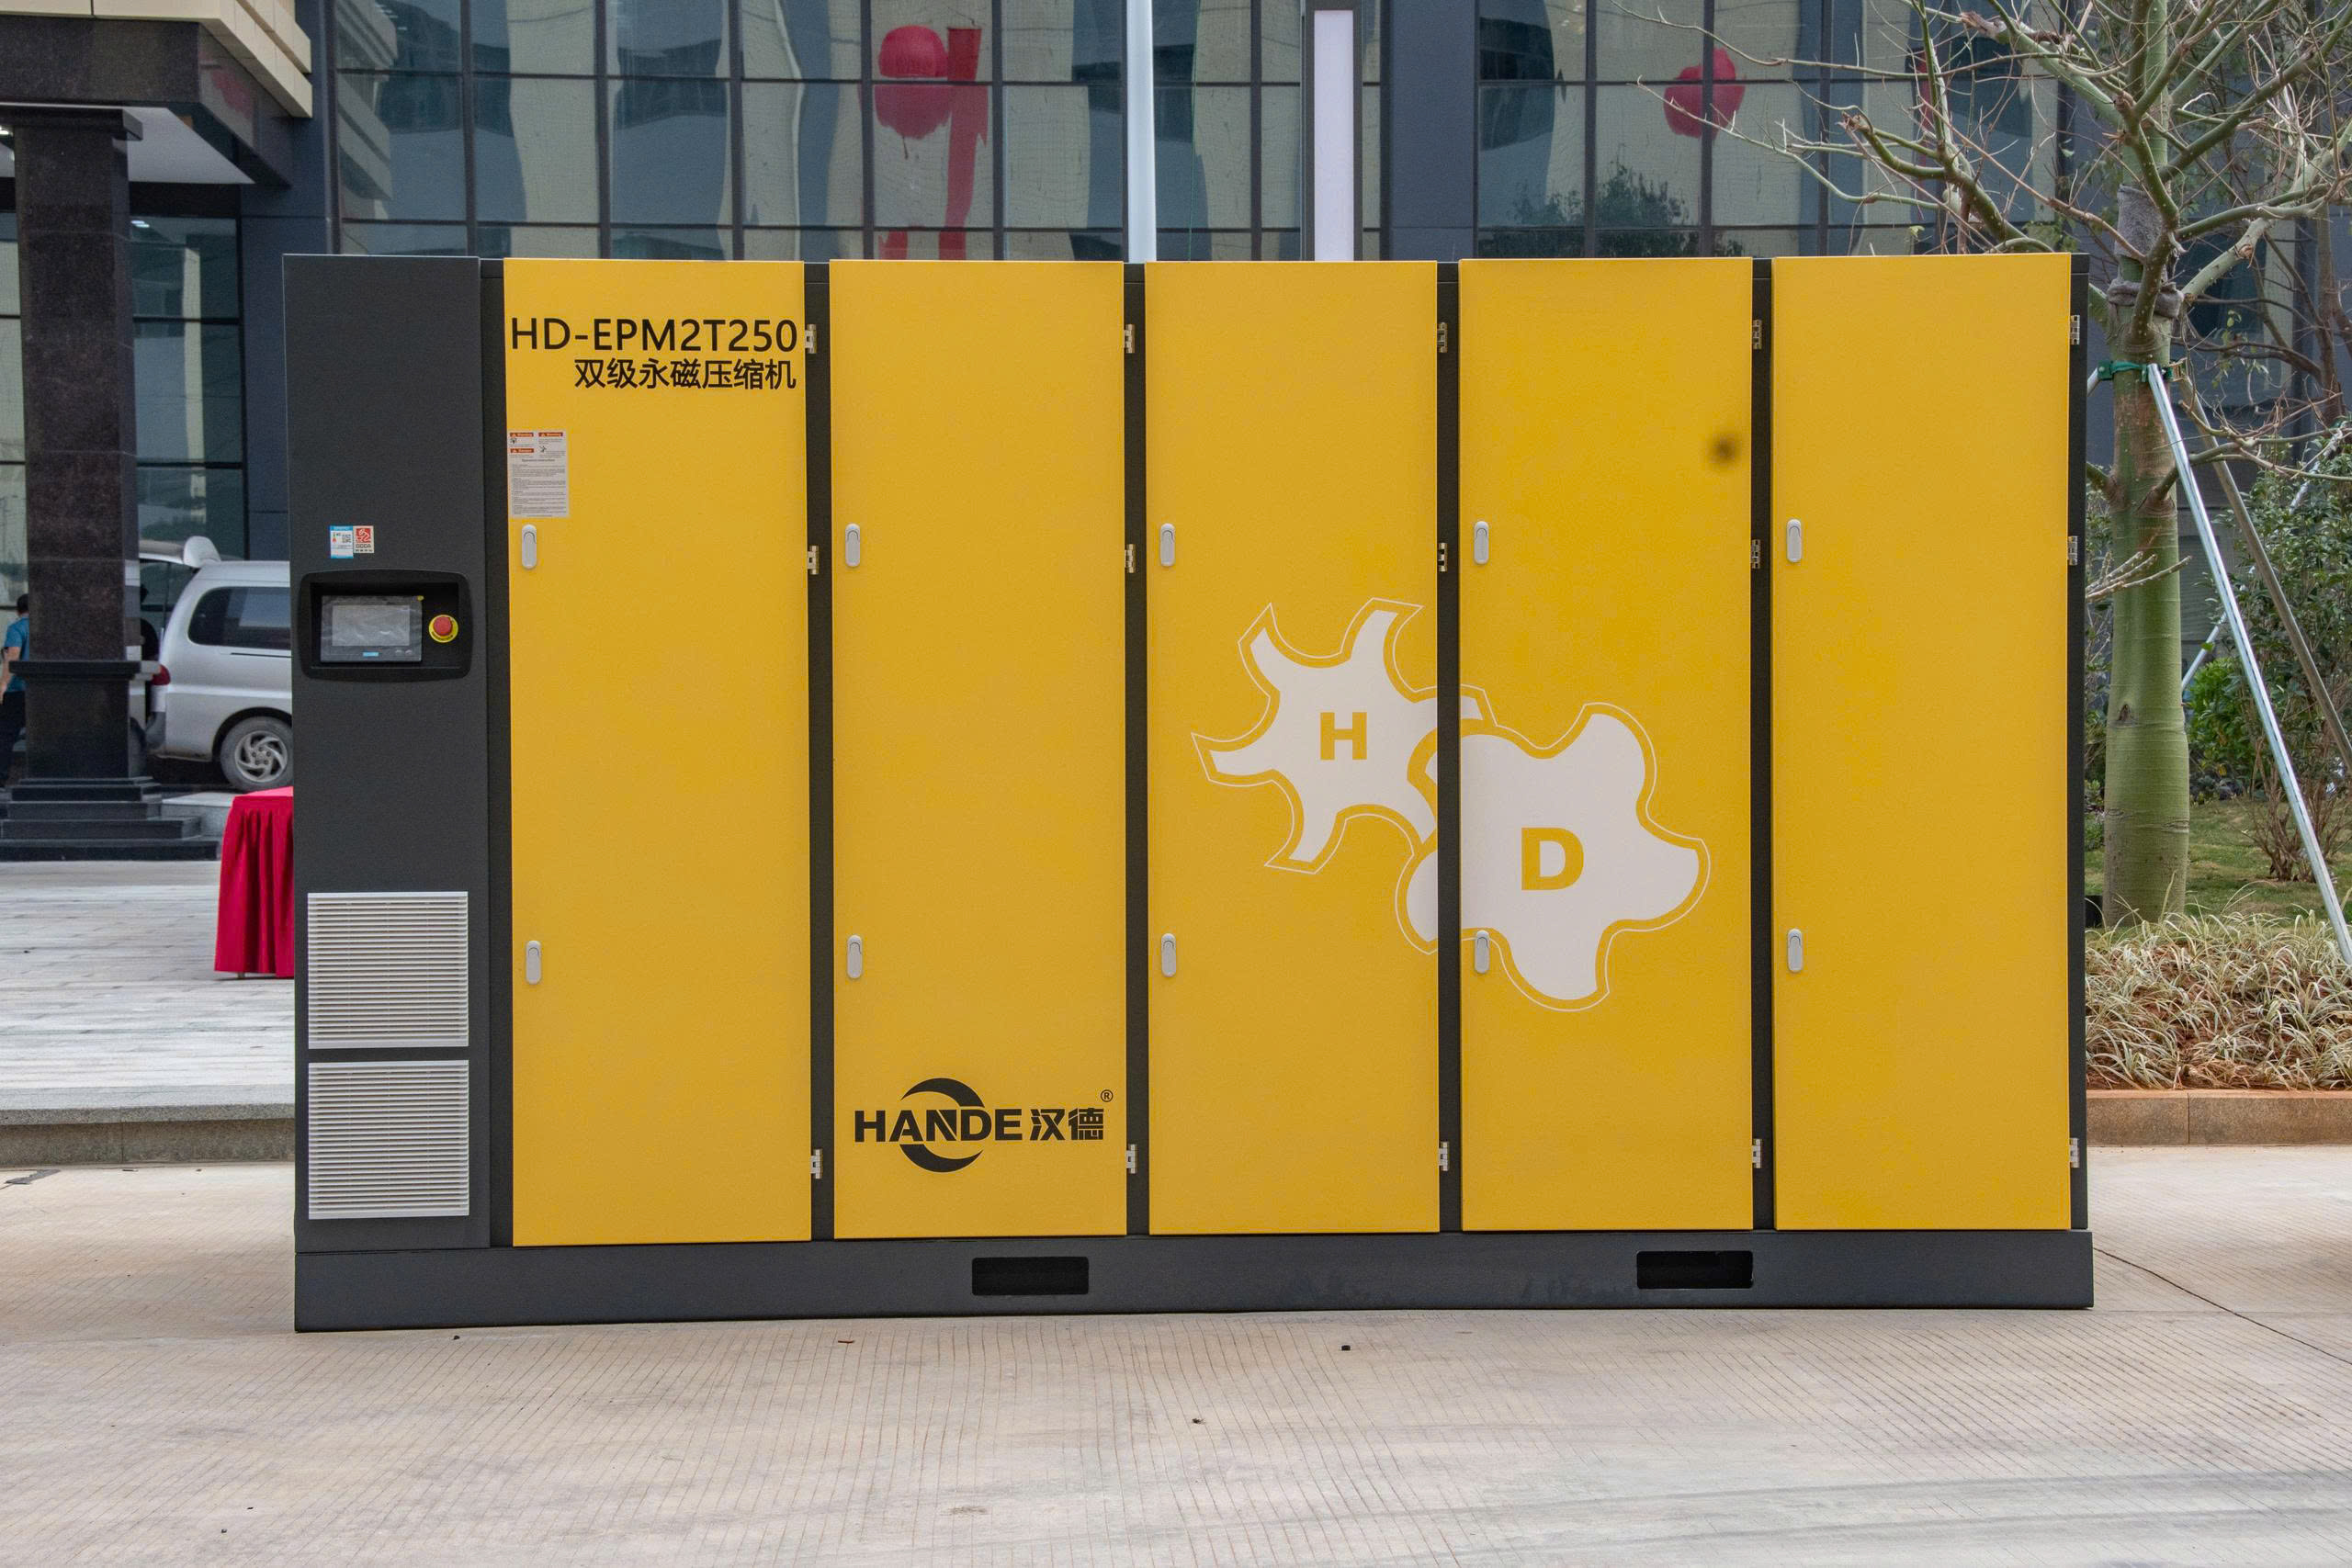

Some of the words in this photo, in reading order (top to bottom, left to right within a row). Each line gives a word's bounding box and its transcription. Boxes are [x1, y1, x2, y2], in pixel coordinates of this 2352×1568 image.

[511, 317, 798, 352] HD-EPM2T250
[573, 357, 797, 389] 双级永磁压缩机
[1319, 711, 1368, 761] H
[1521, 827, 1585, 891] D
[854, 1108, 1023, 1143] HANDE
[1029, 1107, 1104, 1141] 汉德
